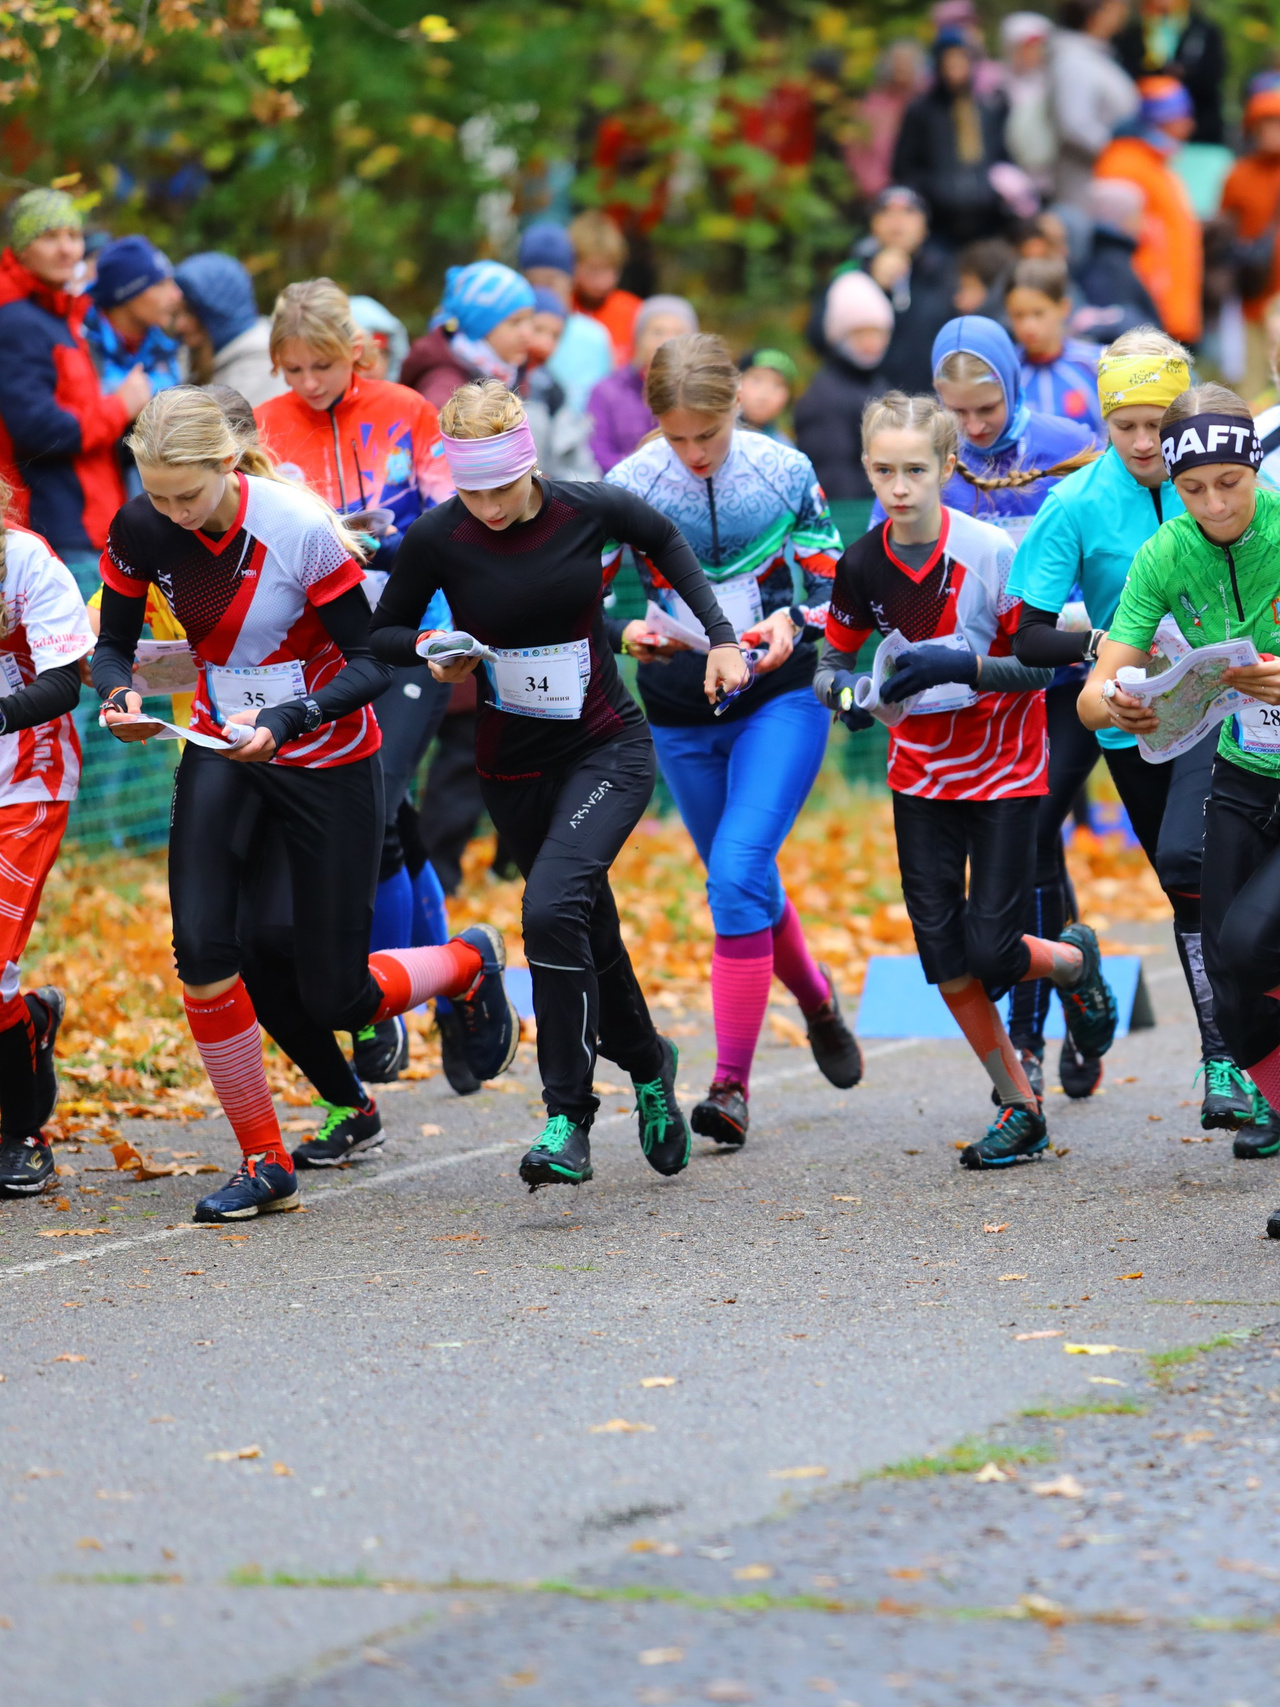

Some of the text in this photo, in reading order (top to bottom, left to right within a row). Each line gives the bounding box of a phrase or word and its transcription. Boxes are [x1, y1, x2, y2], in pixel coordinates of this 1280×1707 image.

[524, 676, 550, 692] 34
[242, 692, 266, 707] 35
[495, 771, 541, 781] Thermo
